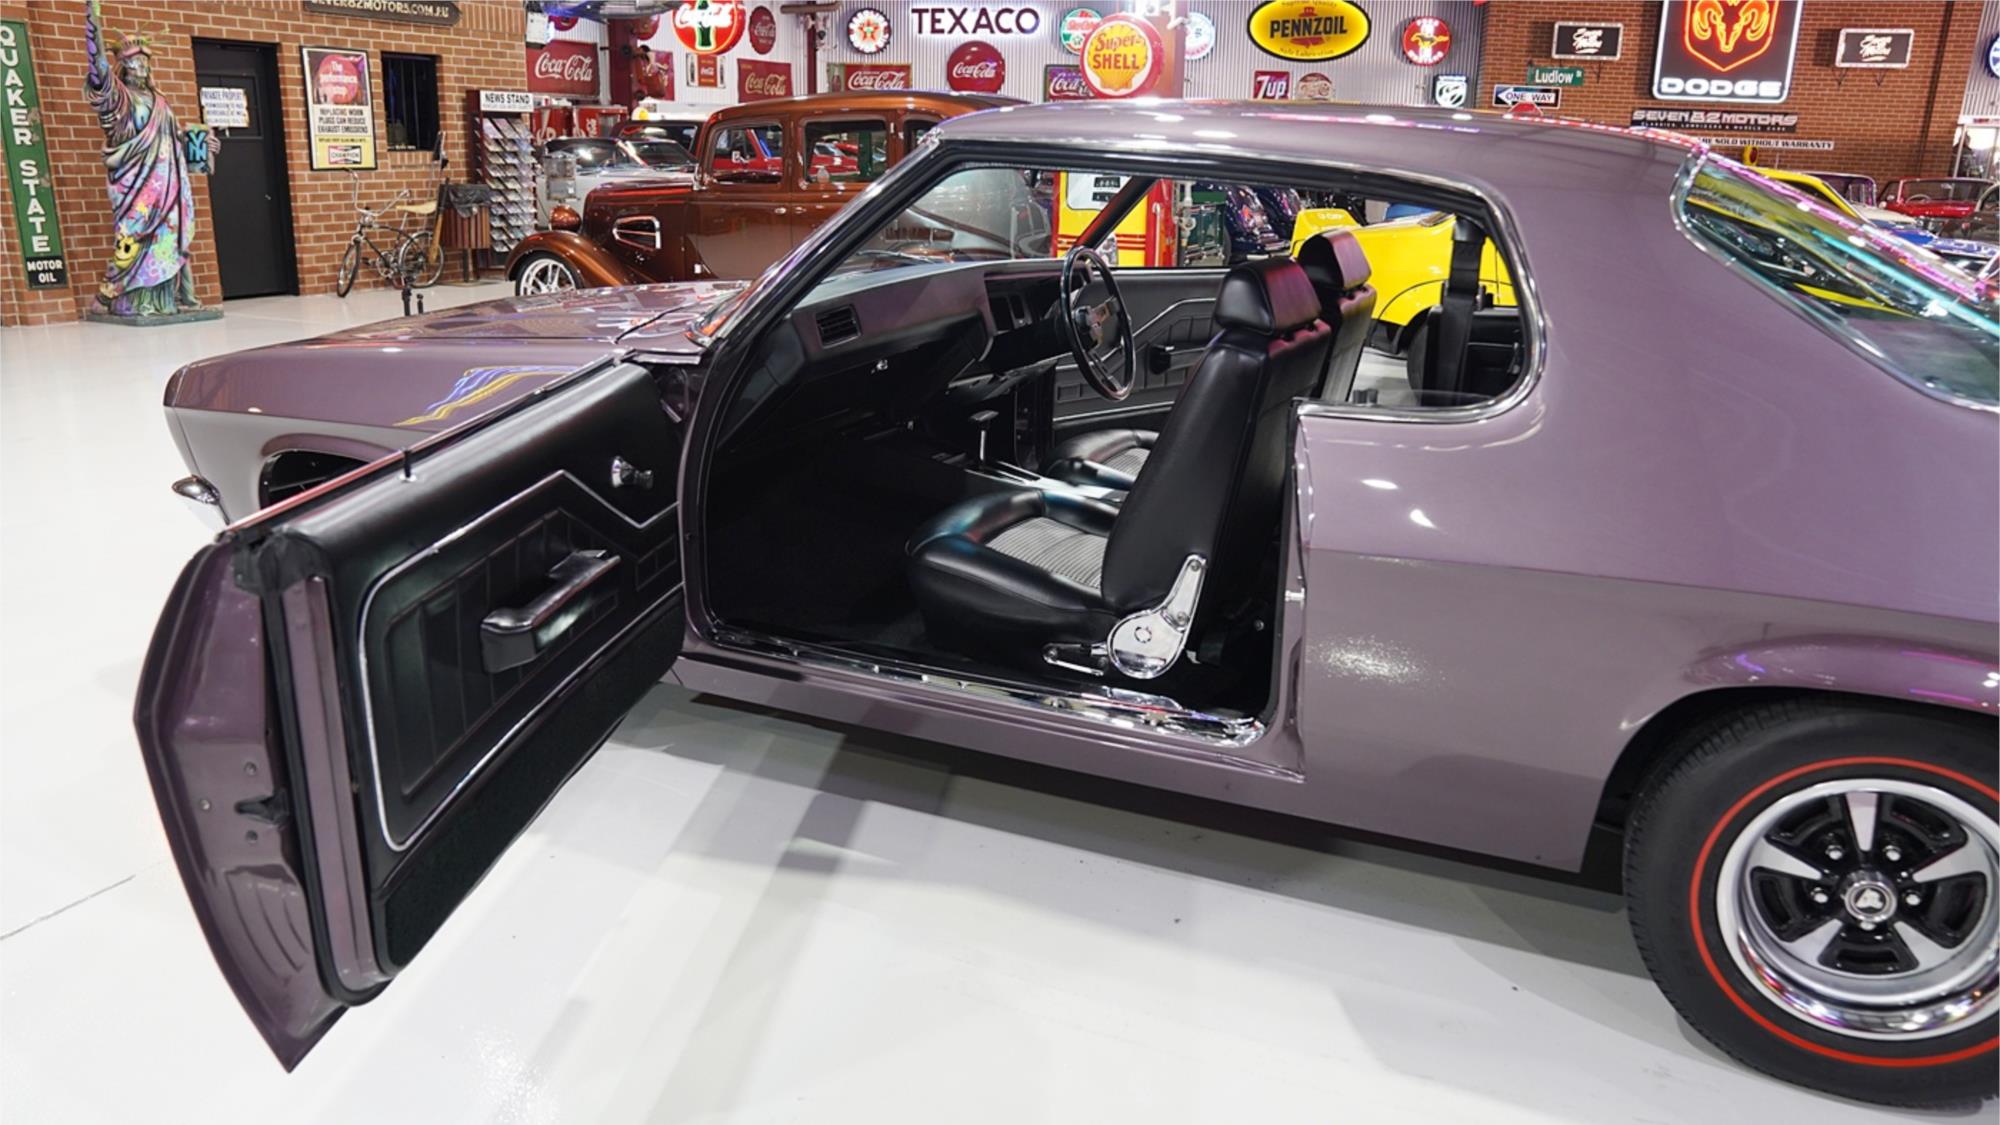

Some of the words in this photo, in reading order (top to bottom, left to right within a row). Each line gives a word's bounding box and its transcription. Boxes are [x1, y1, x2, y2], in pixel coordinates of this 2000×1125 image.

[911, 7, 1040, 34] TEXACO
[1270, 16, 1347, 38] PENNZOIL
[534, 51, 592, 81] Coca-Cola
[1093, 53, 1140, 69] SHELL
[952, 61, 998, 78] Coca-Cola
[1535, 69, 1573, 83] Ludlow
[848, 70, 906, 90] Coca-Cola
[1661, 78, 1782, 97] DODGE
[484, 93, 505, 103] NEWS
[506, 94, 530, 104] STAND
[1506, 92, 1526, 100] ONE
[1531, 94, 1552, 102] WAY
[1721, 113, 1798, 126] MOTORS
[0, 25, 33, 145] QUAKER
[19, 159, 51, 252] STATE
[1714, 138, 1738, 146] SOLD
[1739, 139, 1779, 147] WITHOUT
[1781, 141, 1832, 150] WARRANTY
[26, 259, 63, 272] MOTOR
[38, 272, 57, 284] OIL
